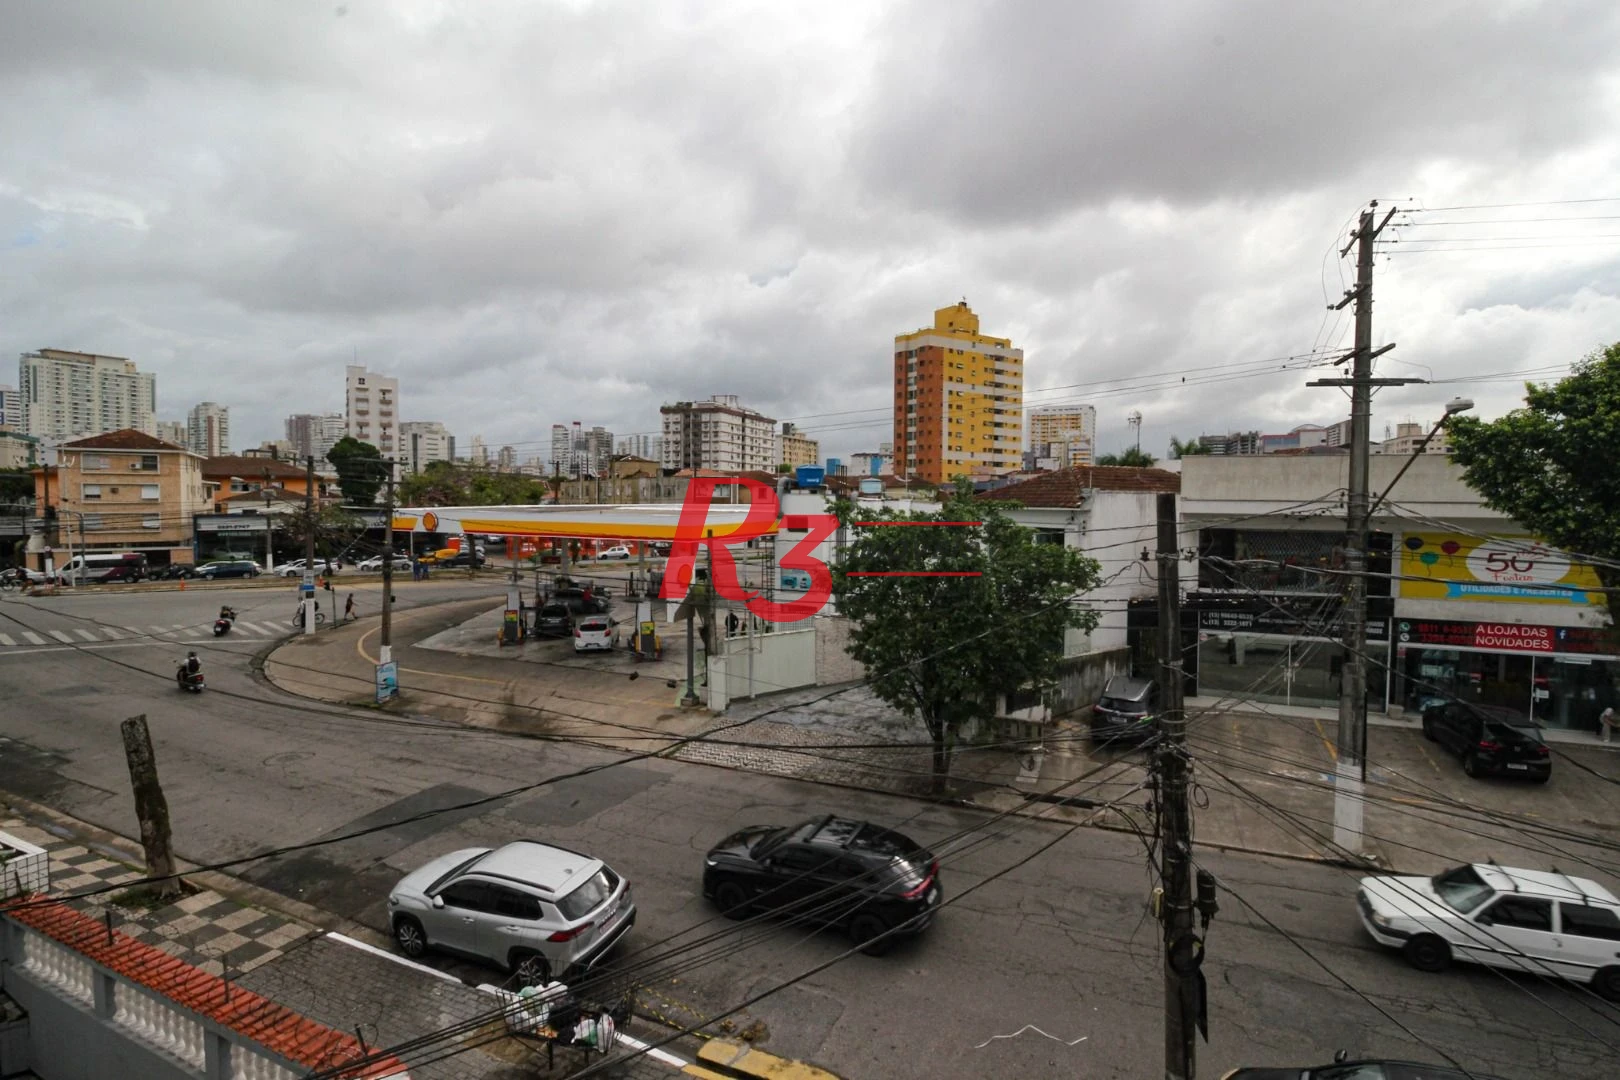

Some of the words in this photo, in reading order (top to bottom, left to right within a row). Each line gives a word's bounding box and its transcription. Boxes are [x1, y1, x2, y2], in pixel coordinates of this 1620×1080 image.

[1460, 584, 1512, 594] UTILIDADES
[1476, 624, 1485, 634] A
[1487, 625, 1519, 636] LOJA
[1521, 627, 1548, 637] DAS
[1475, 635, 1553, 649] NOVIDADES.
